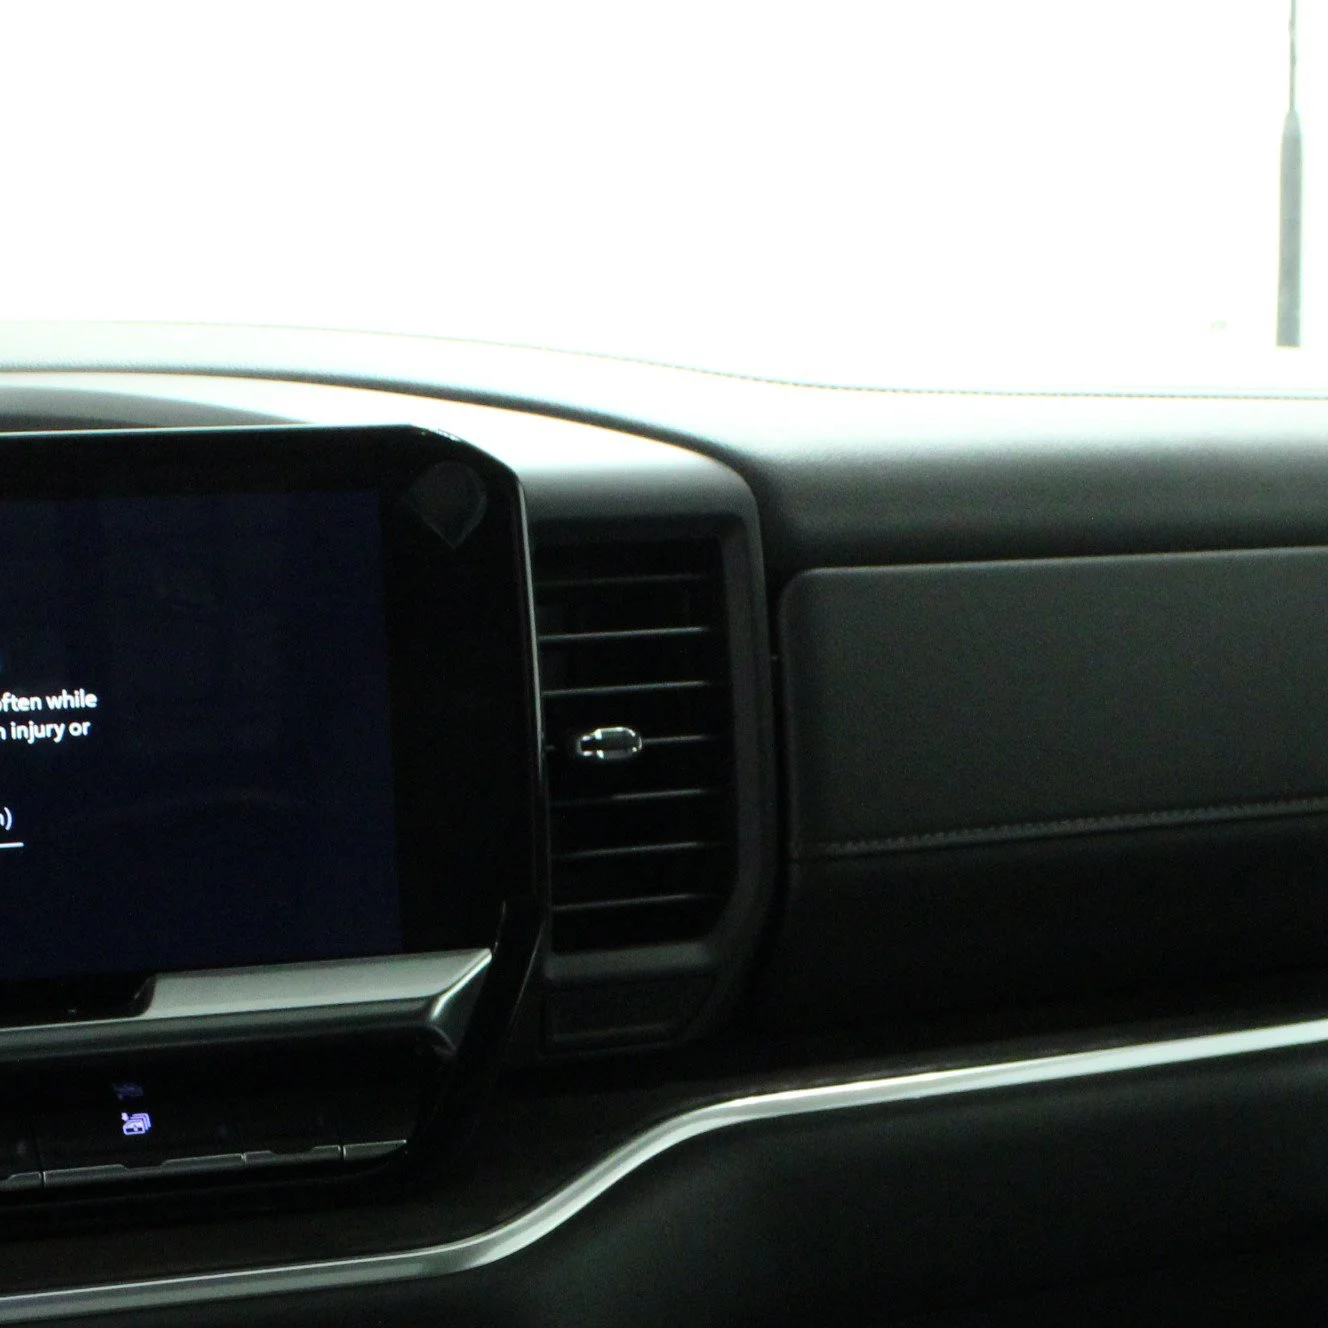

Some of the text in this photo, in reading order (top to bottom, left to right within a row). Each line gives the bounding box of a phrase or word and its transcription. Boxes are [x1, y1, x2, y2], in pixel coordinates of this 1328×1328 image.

[45, 688, 98, 710] while
[9, 720, 66, 745] injury
[68, 721, 92, 737] or
